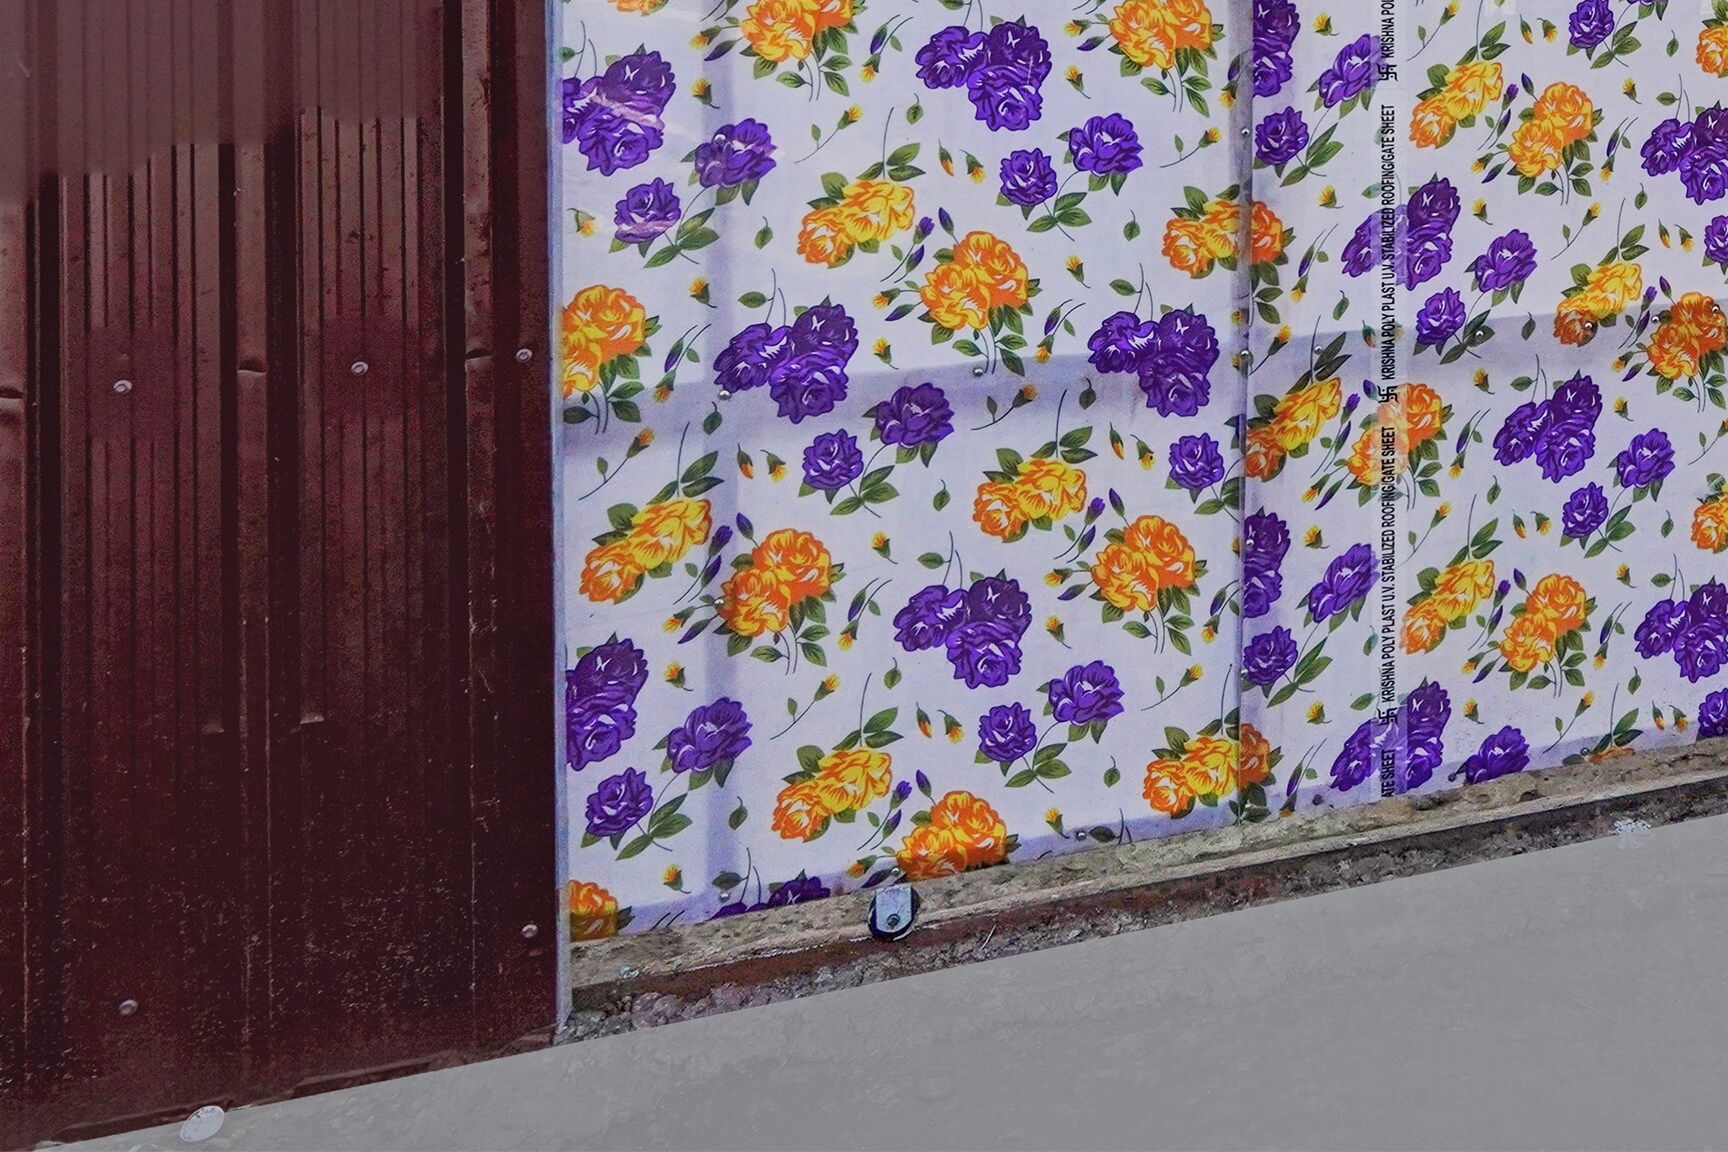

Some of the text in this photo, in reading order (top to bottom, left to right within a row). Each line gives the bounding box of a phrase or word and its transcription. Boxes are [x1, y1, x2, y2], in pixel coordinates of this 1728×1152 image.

[1381, 17, 1395, 58] KRISHNA
[1381, 104, 1395, 380] KRISHNA POLY PLAST U.V. STABILIZED ROOFING/GATE SHEET
[1381, 426, 1395, 702] KRISHNA POLY PLAST U.V. STABILIZED ROOFING/GATE SHEET
[1381, 749, 1395, 780] SHEET
